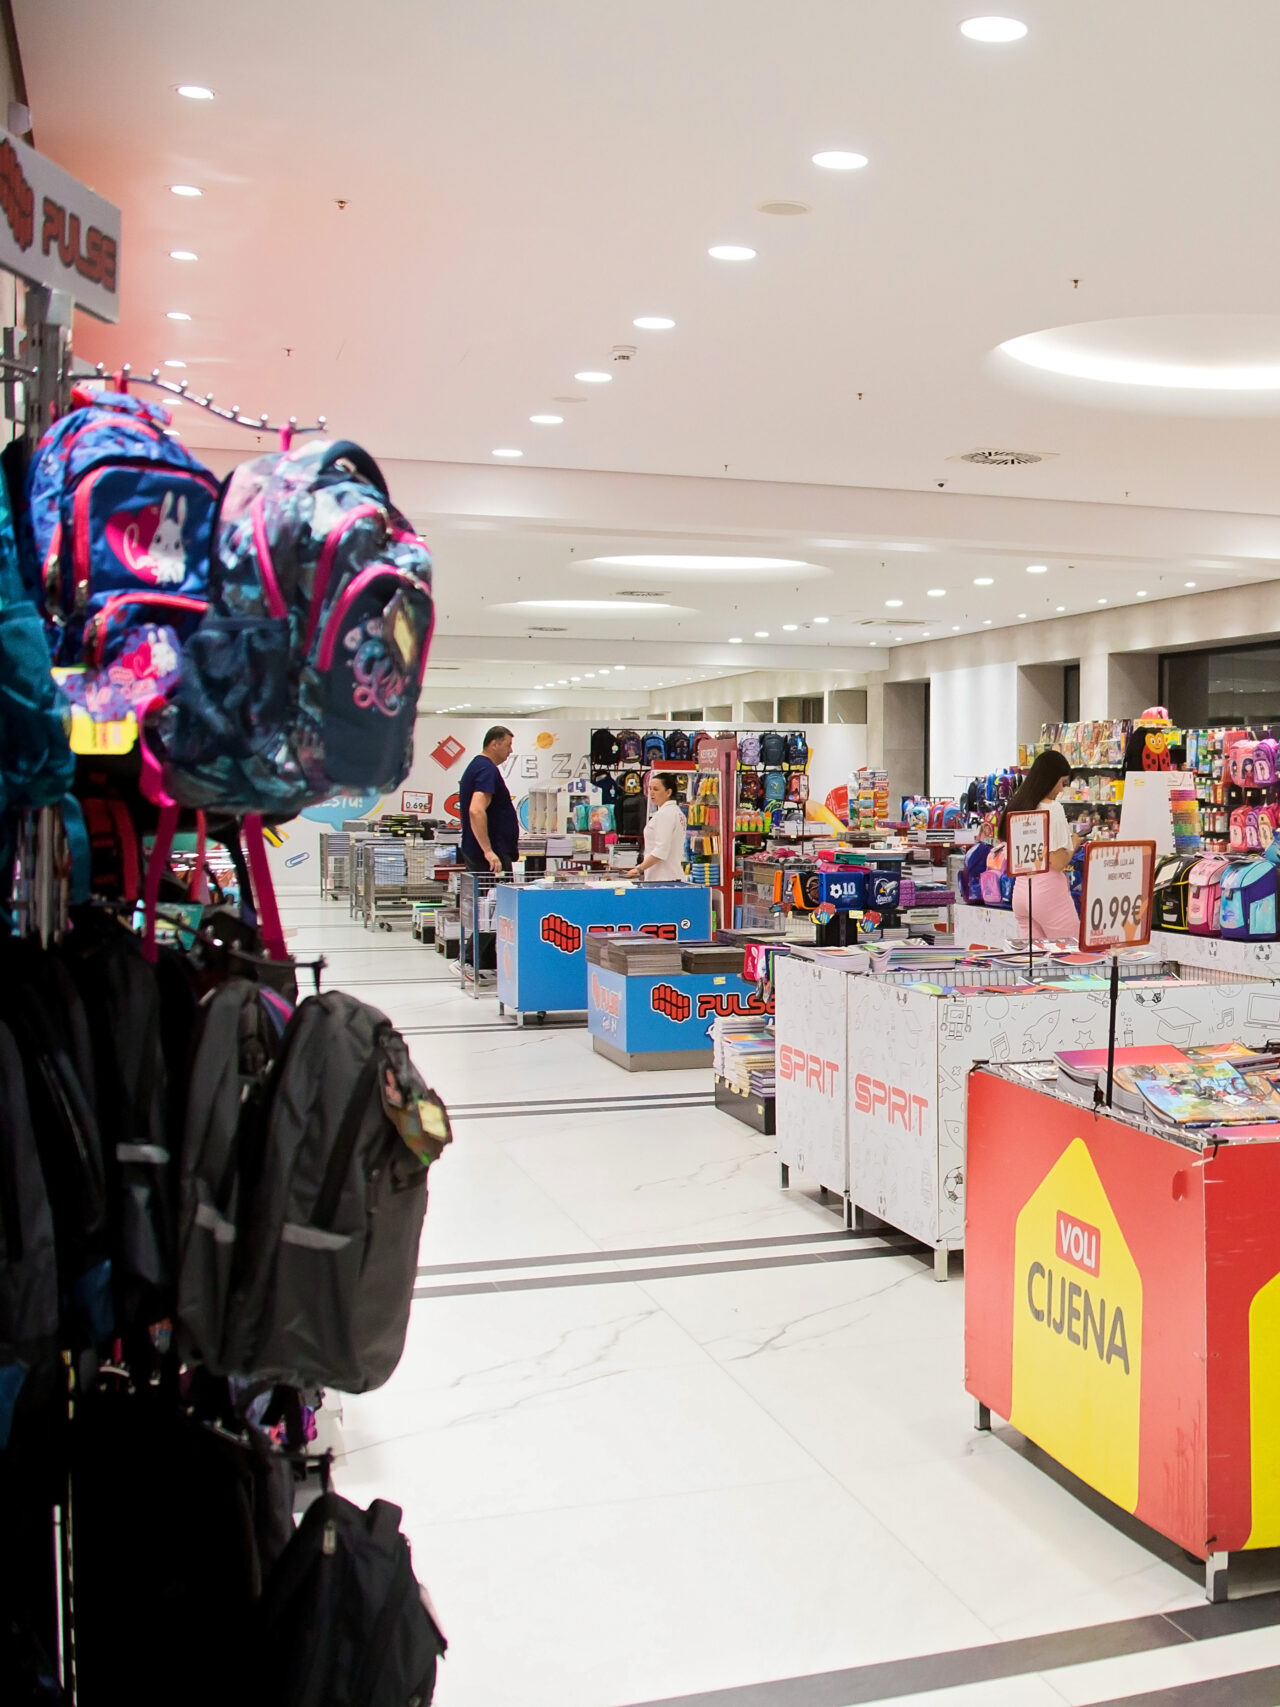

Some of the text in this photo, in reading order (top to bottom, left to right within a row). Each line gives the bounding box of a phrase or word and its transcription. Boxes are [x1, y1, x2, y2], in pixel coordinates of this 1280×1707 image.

[42, 195, 117, 294] PULSE
[499, 754, 538, 779] VE
[1015, 842, 1044, 865] 1.25€
[1091, 894, 1142, 931] 0.99€
[780, 1044, 839, 1098] SPIRIT
[855, 1073, 929, 1136] SPIRIT
[1060, 1218, 1098, 1269] VOLI
[1028, 1260, 1131, 1376] CIJENA
